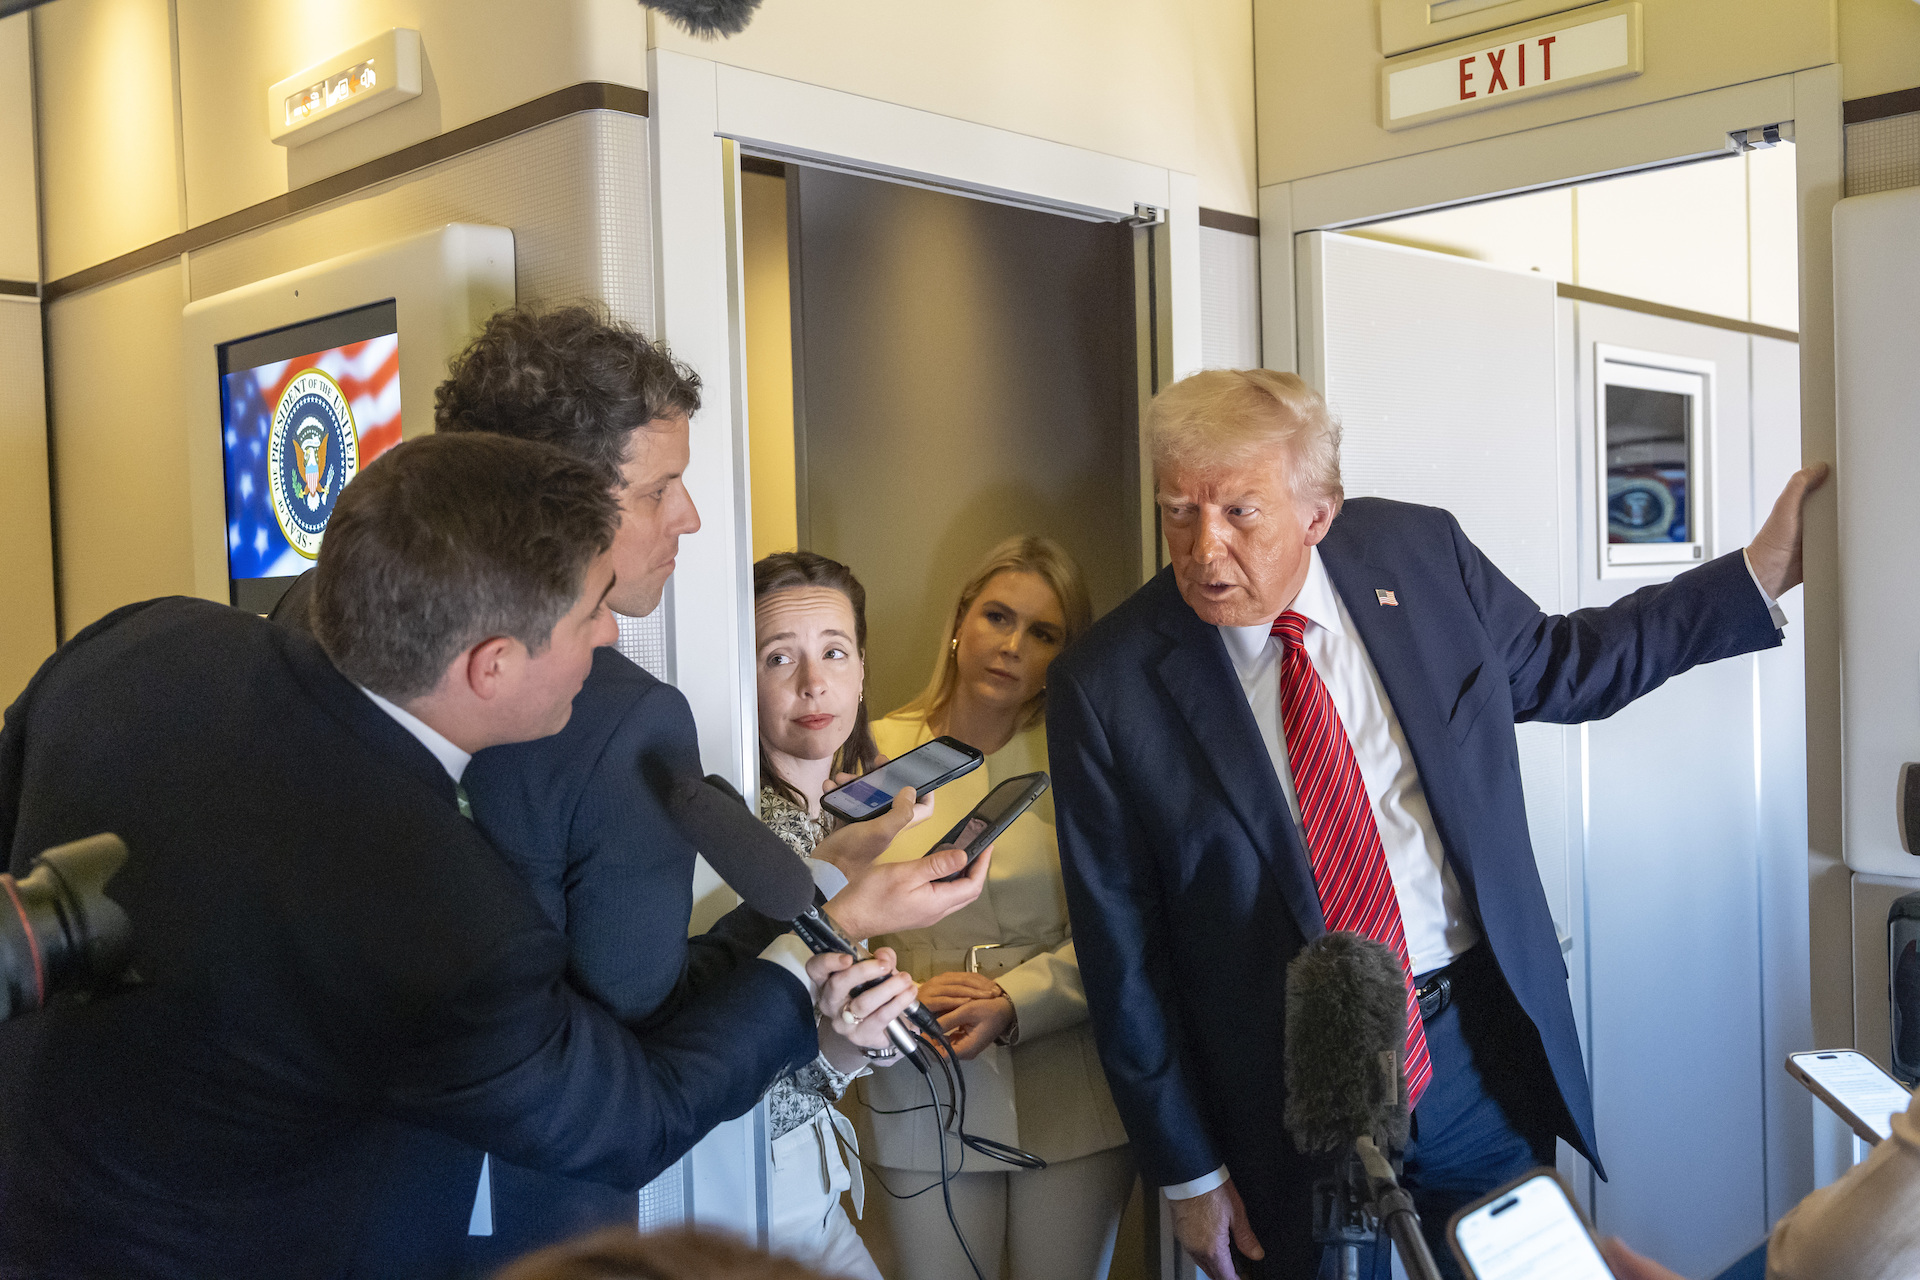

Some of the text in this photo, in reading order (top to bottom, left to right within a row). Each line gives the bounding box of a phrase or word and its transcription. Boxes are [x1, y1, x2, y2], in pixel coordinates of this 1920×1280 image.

[1460, 36, 1556, 100] EXIT
[272, 378, 355, 548] SEAL OF THE PRESIDENT OF THE UNITED
